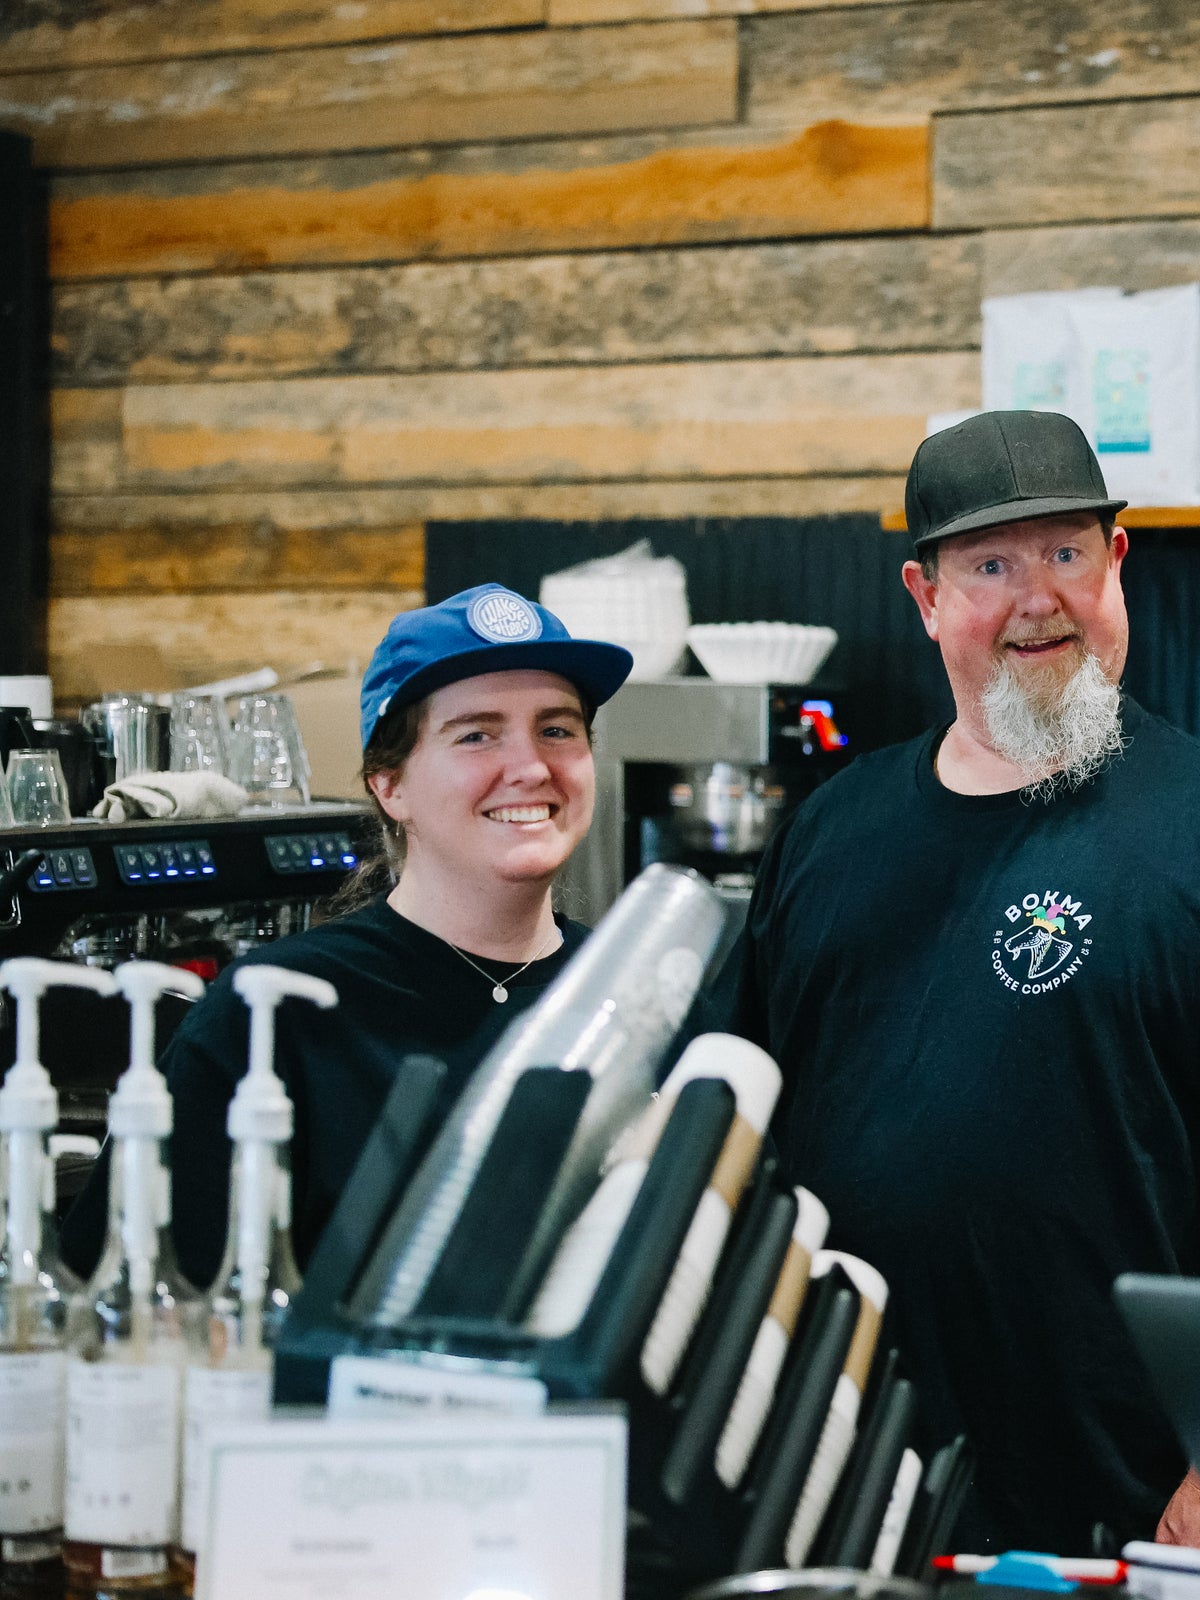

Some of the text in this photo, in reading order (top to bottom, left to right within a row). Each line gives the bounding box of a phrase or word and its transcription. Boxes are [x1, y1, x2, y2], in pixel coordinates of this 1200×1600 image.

[1004, 890, 1093, 931] BOKMA
[991, 950, 1083, 995] COFFEE COMPANY
